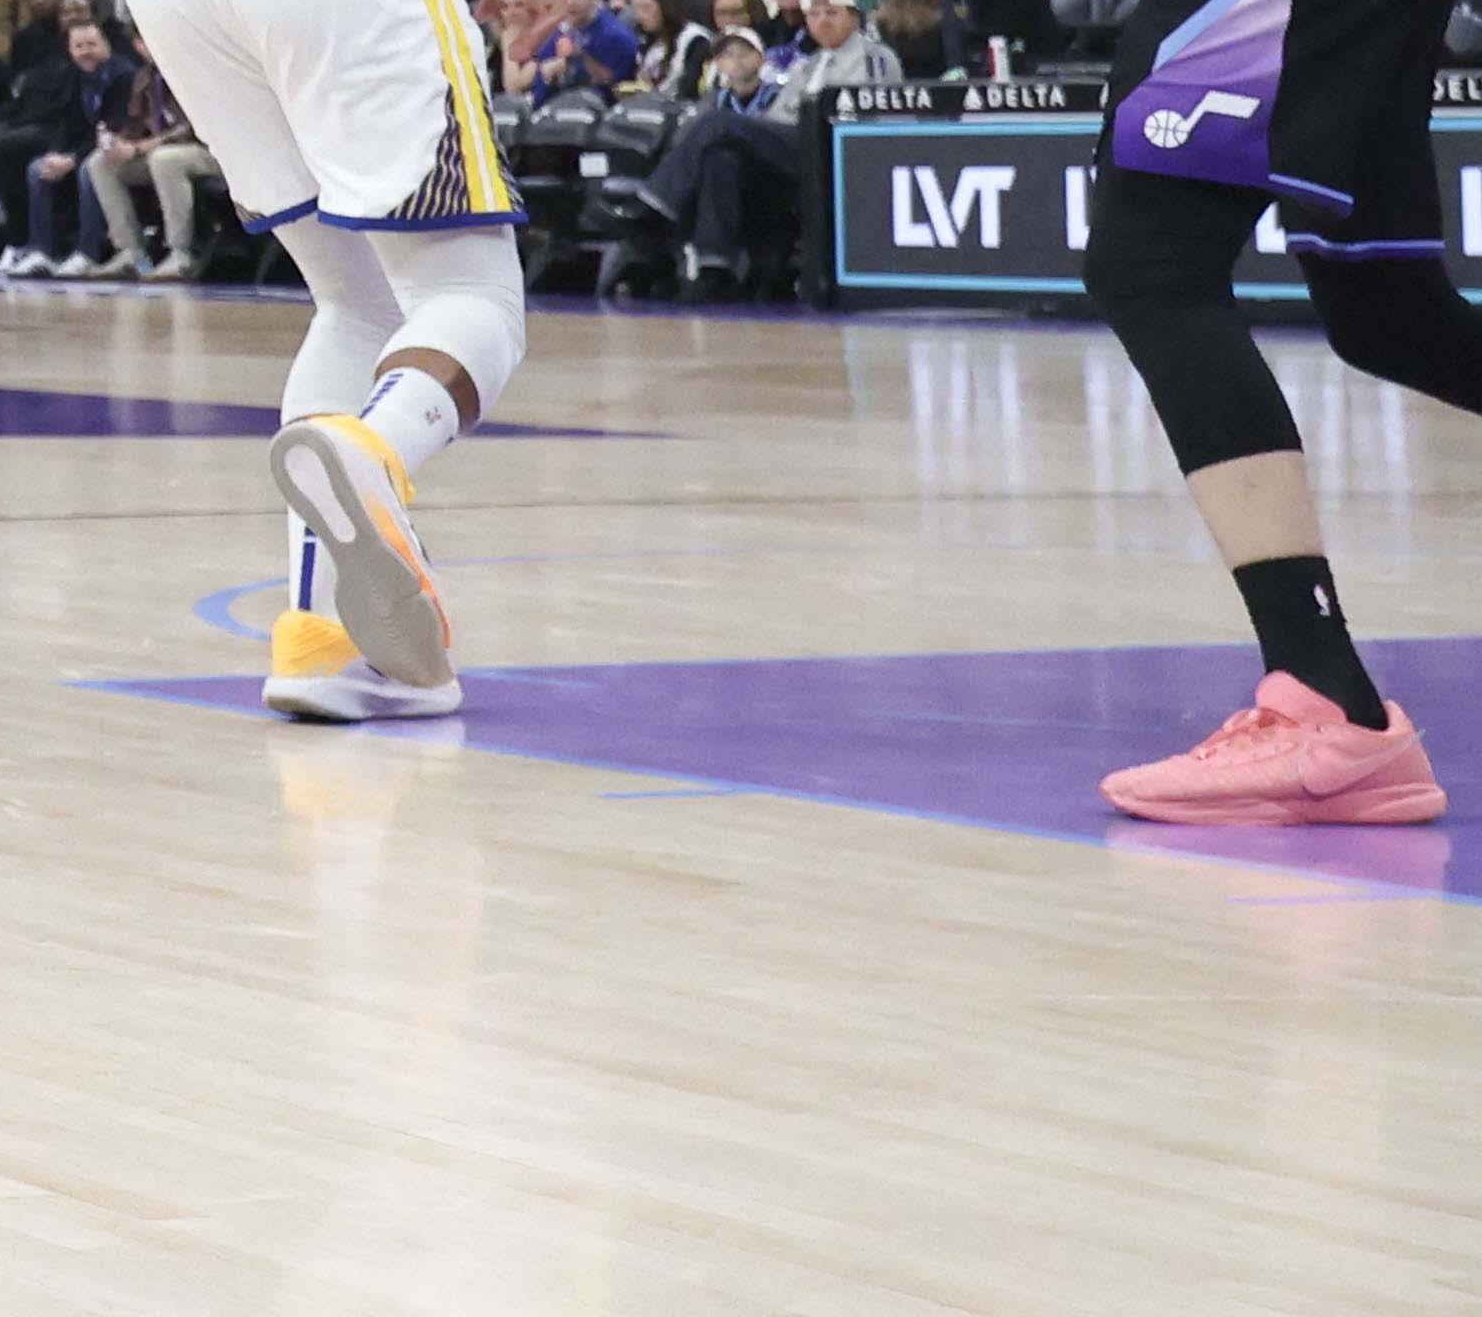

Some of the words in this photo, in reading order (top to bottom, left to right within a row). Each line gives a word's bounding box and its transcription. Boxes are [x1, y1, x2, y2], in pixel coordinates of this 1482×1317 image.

[857, 85, 934, 111] DELTA
[986, 83, 1067, 109] DELTA
[890, 165, 1016, 249] LVT
